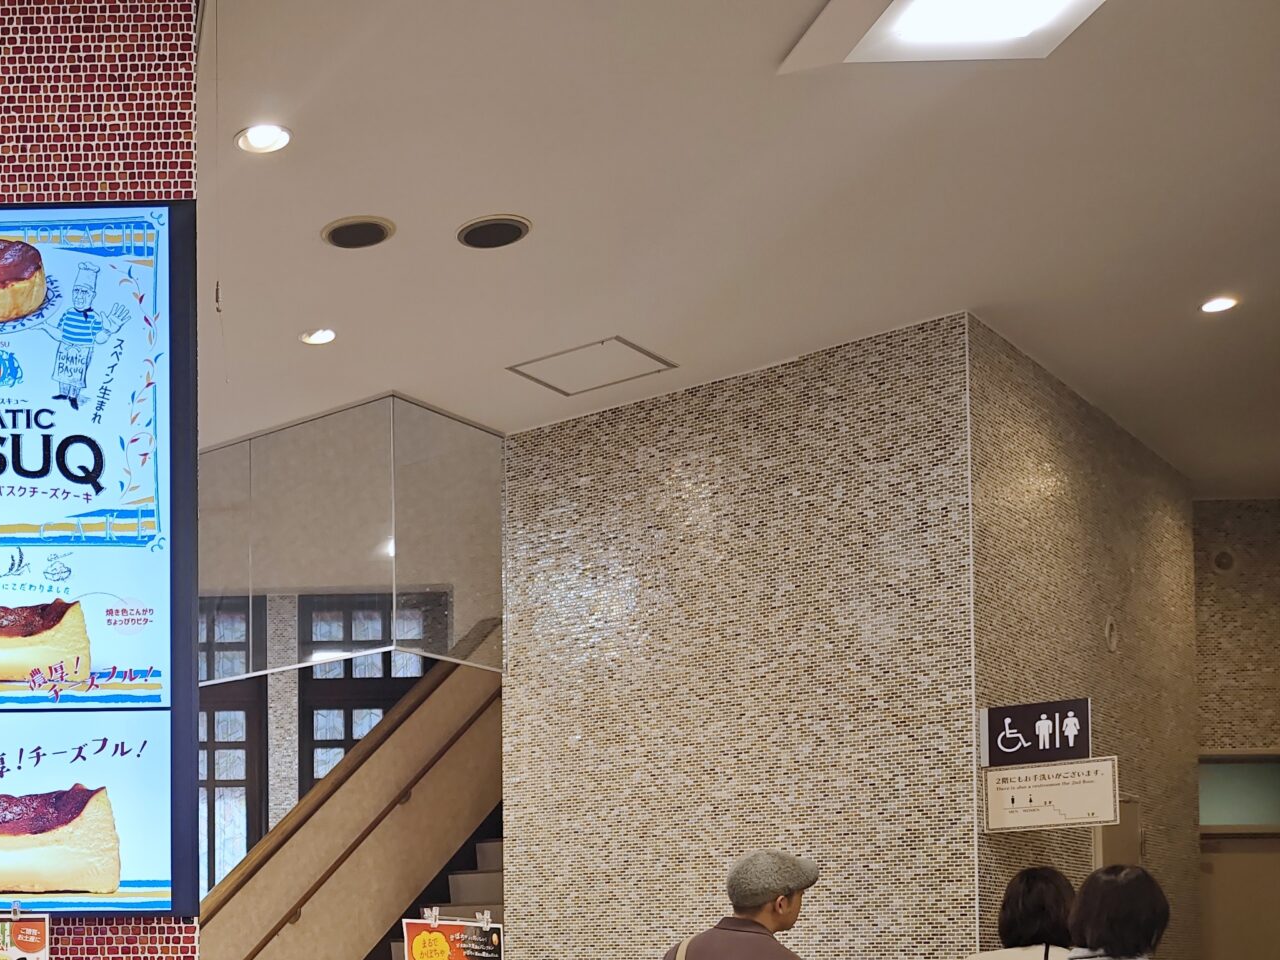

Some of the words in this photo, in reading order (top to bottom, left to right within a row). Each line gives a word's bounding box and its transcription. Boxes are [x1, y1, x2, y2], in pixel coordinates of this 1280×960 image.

[19, 223, 149, 256] TOKACHI
[91, 338, 125, 425] スペイン生まれ
[105, 608, 154, 617] 焼き色こんがり
